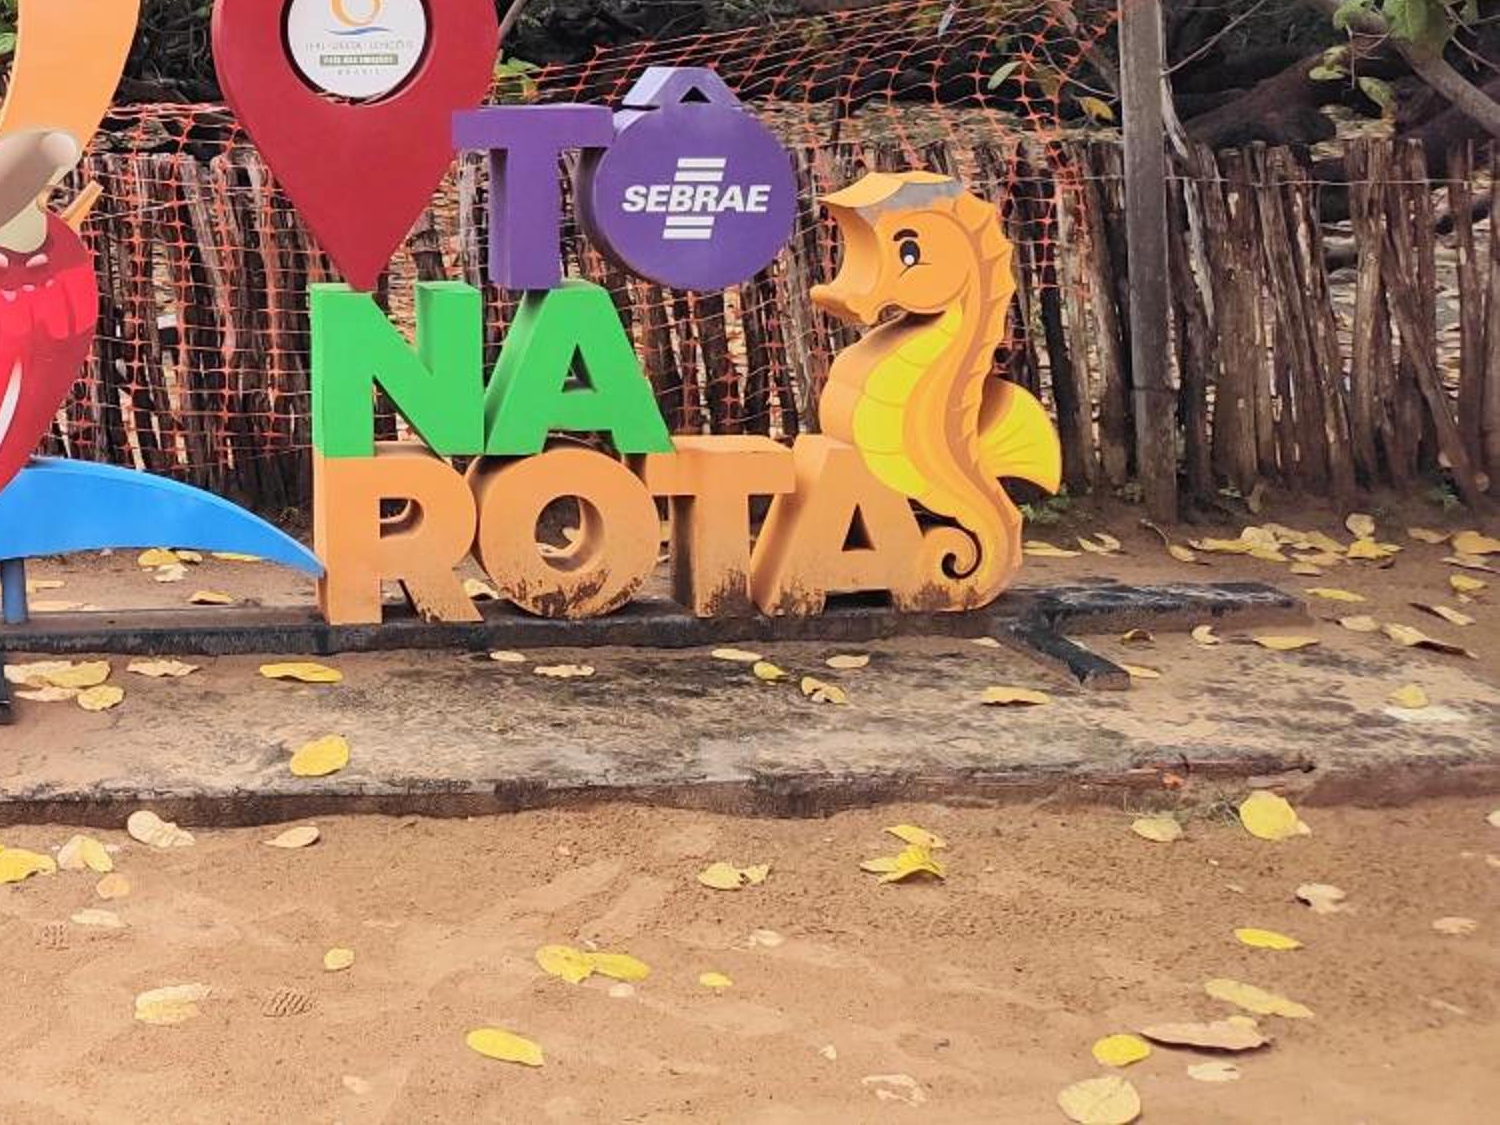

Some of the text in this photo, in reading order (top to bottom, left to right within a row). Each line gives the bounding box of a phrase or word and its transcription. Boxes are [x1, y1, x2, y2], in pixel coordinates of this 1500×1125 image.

[452, 67, 796, 289] TÔ
[622, 184, 771, 213] SEBRAE
[310, 281, 673, 457] NA
[314, 435, 942, 624] ROTA
